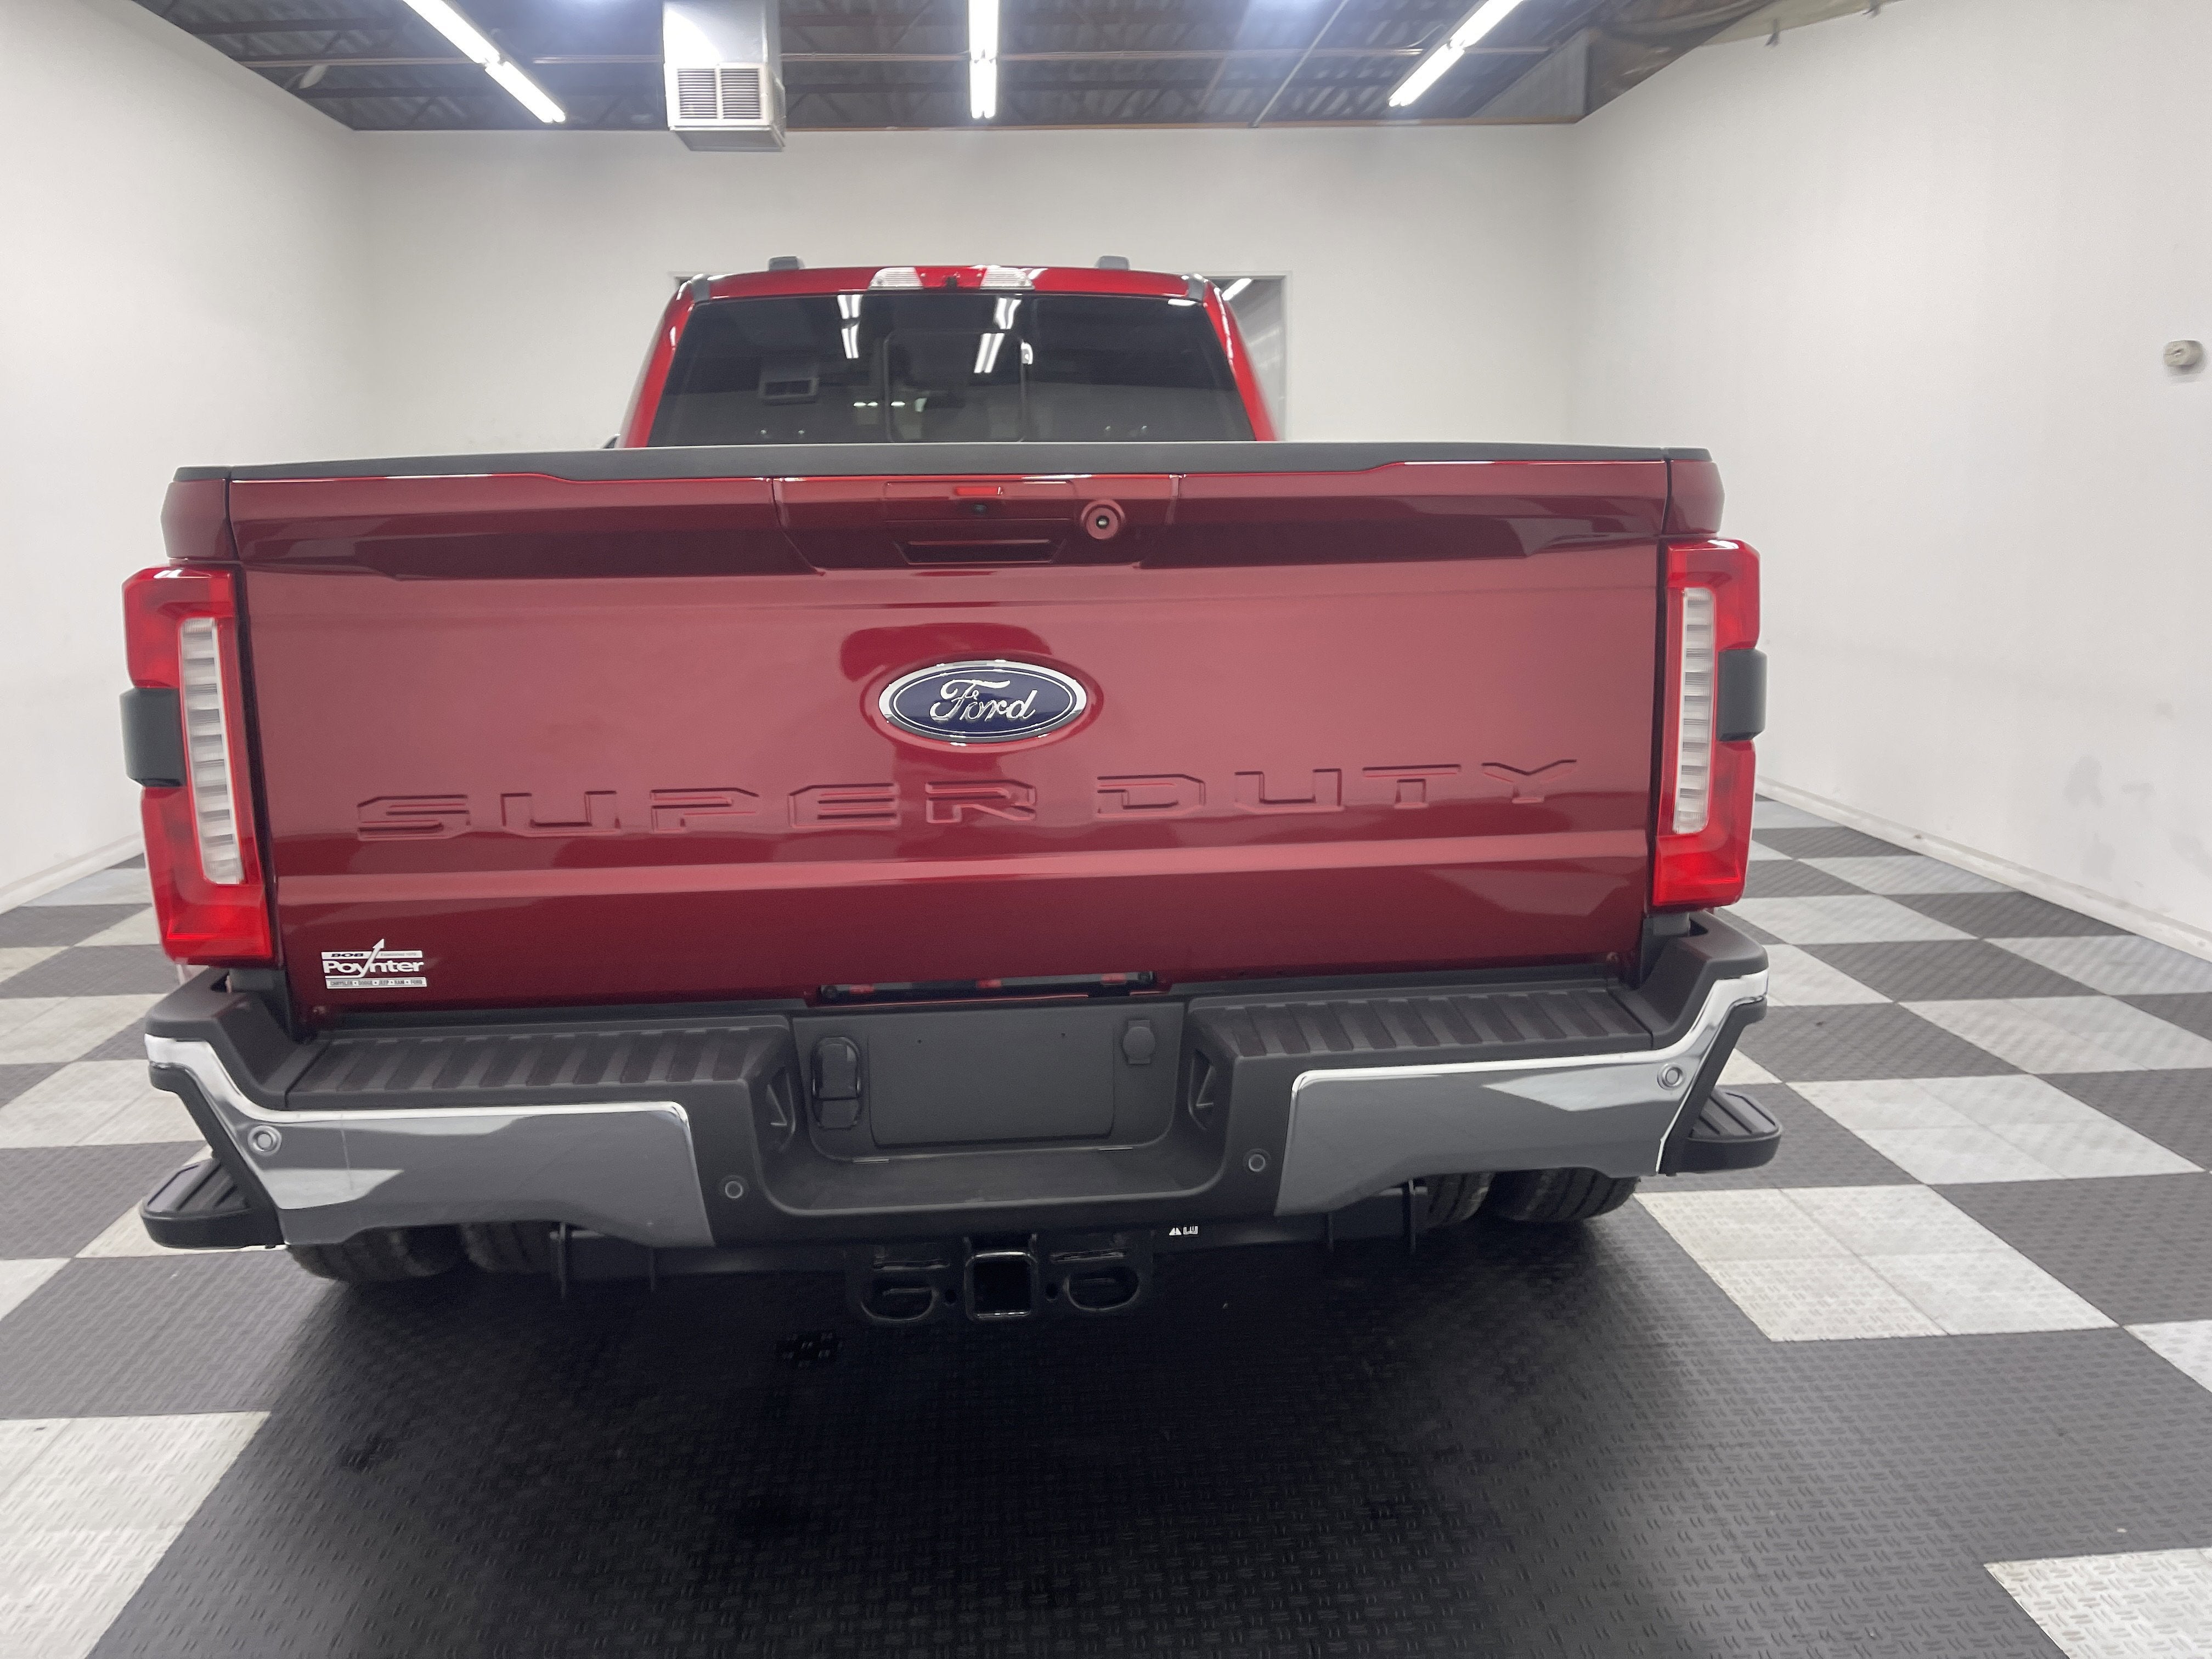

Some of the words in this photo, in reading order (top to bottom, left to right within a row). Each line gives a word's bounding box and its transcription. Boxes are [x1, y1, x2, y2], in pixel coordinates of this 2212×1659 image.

[929, 679, 1038, 721] Ford
[357, 779, 1037, 841] SUPER
[1097, 759, 1577, 820] DUTY
[323, 959, 425, 978] Poynter
